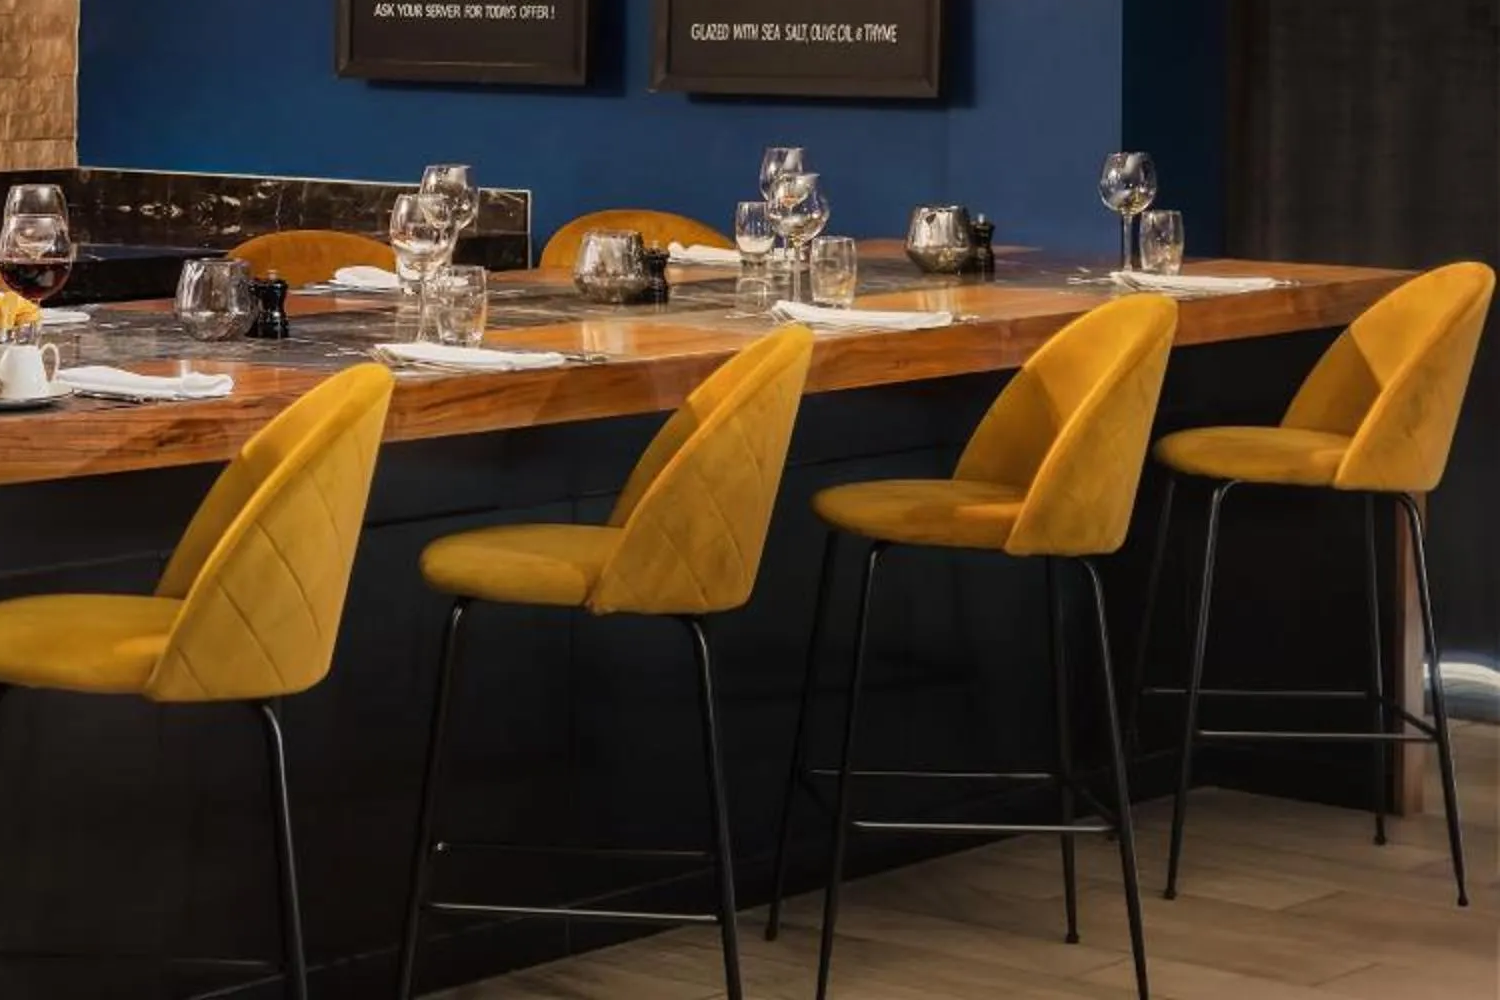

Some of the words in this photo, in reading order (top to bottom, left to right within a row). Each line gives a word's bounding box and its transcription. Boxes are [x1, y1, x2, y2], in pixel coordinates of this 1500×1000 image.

[373, 3, 395, 17] ASK
[397, 3, 423, 17] YOUR
[425, 4, 461, 18] SERVER
[464, 4, 483, 18] FOR
[691, 23, 729, 41] GLAZED
[733, 23, 759, 41] WITH
[761, 23, 781, 41] SEA
[810, 23, 837, 41] OLIVE
[837, 23, 853, 42] OIL
[863, 23, 897, 43] THYME
